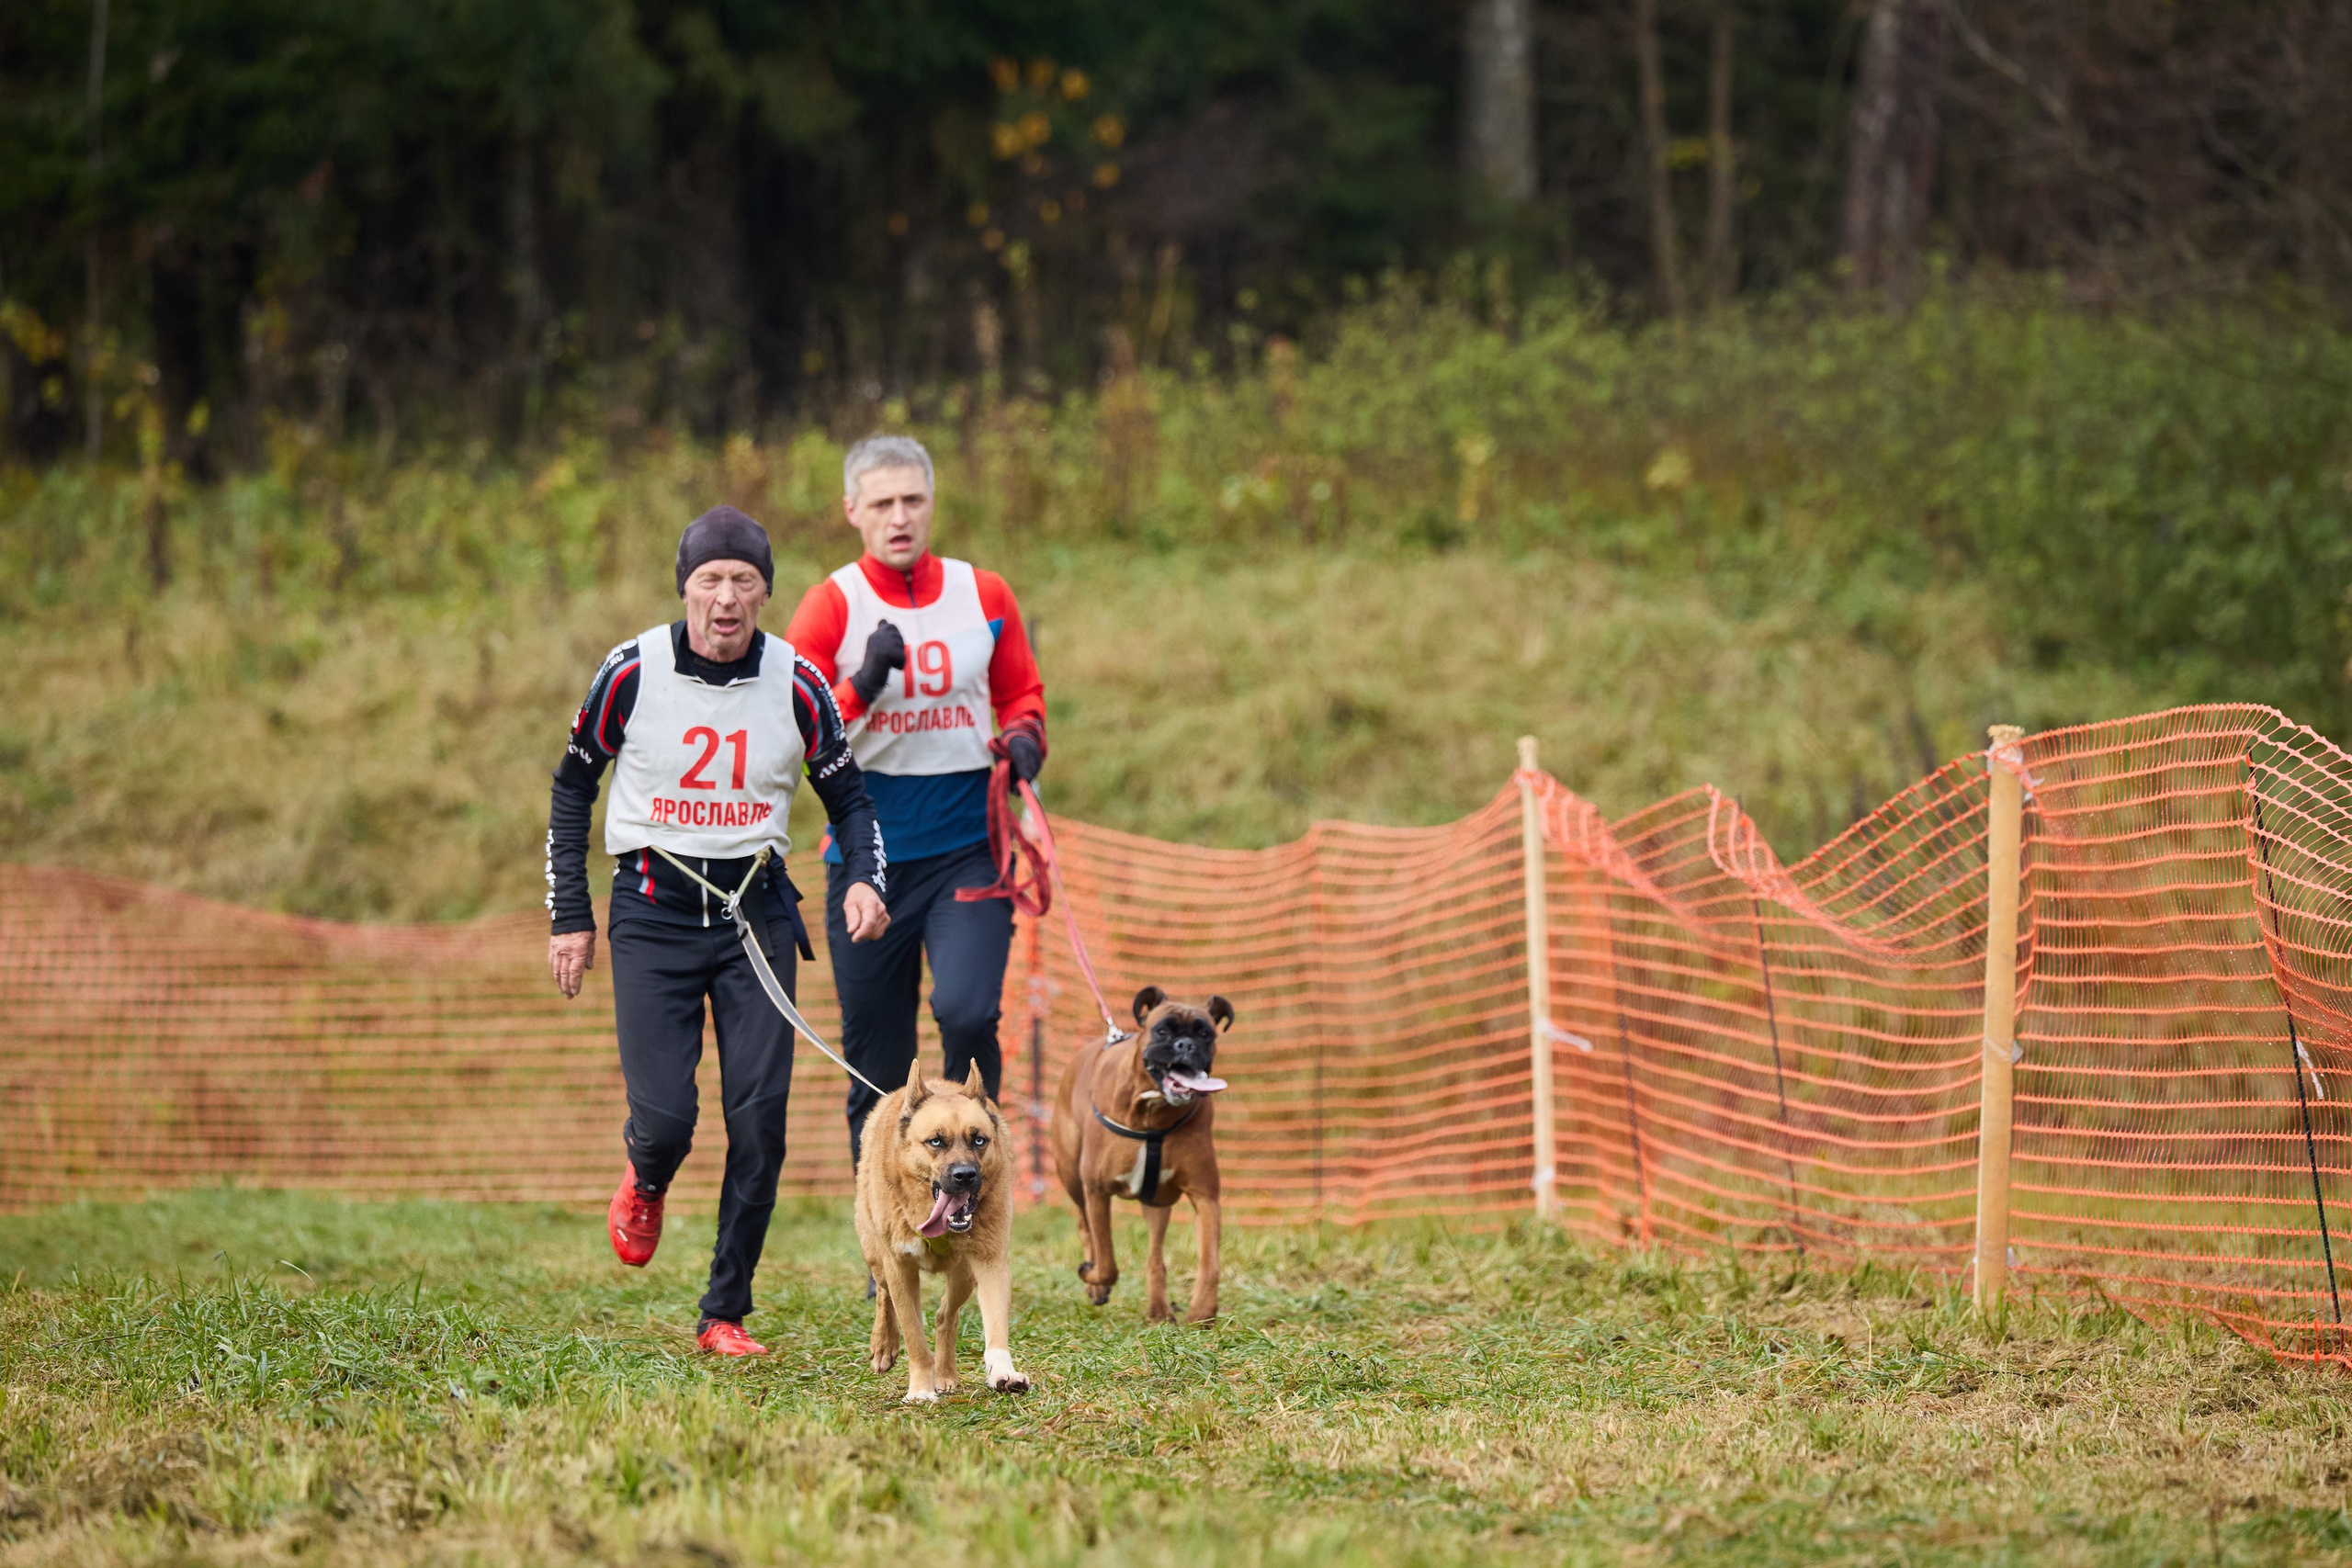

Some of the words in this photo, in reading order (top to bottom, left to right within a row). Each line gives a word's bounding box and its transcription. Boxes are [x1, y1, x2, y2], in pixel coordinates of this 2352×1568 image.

[902, 640, 954, 699] 19
[865, 705, 976, 734] ЯРОСЛАВЛЬ
[680, 726, 747, 790] 21
[650, 797, 773, 827] ЯРОСЛАВЛЬ
